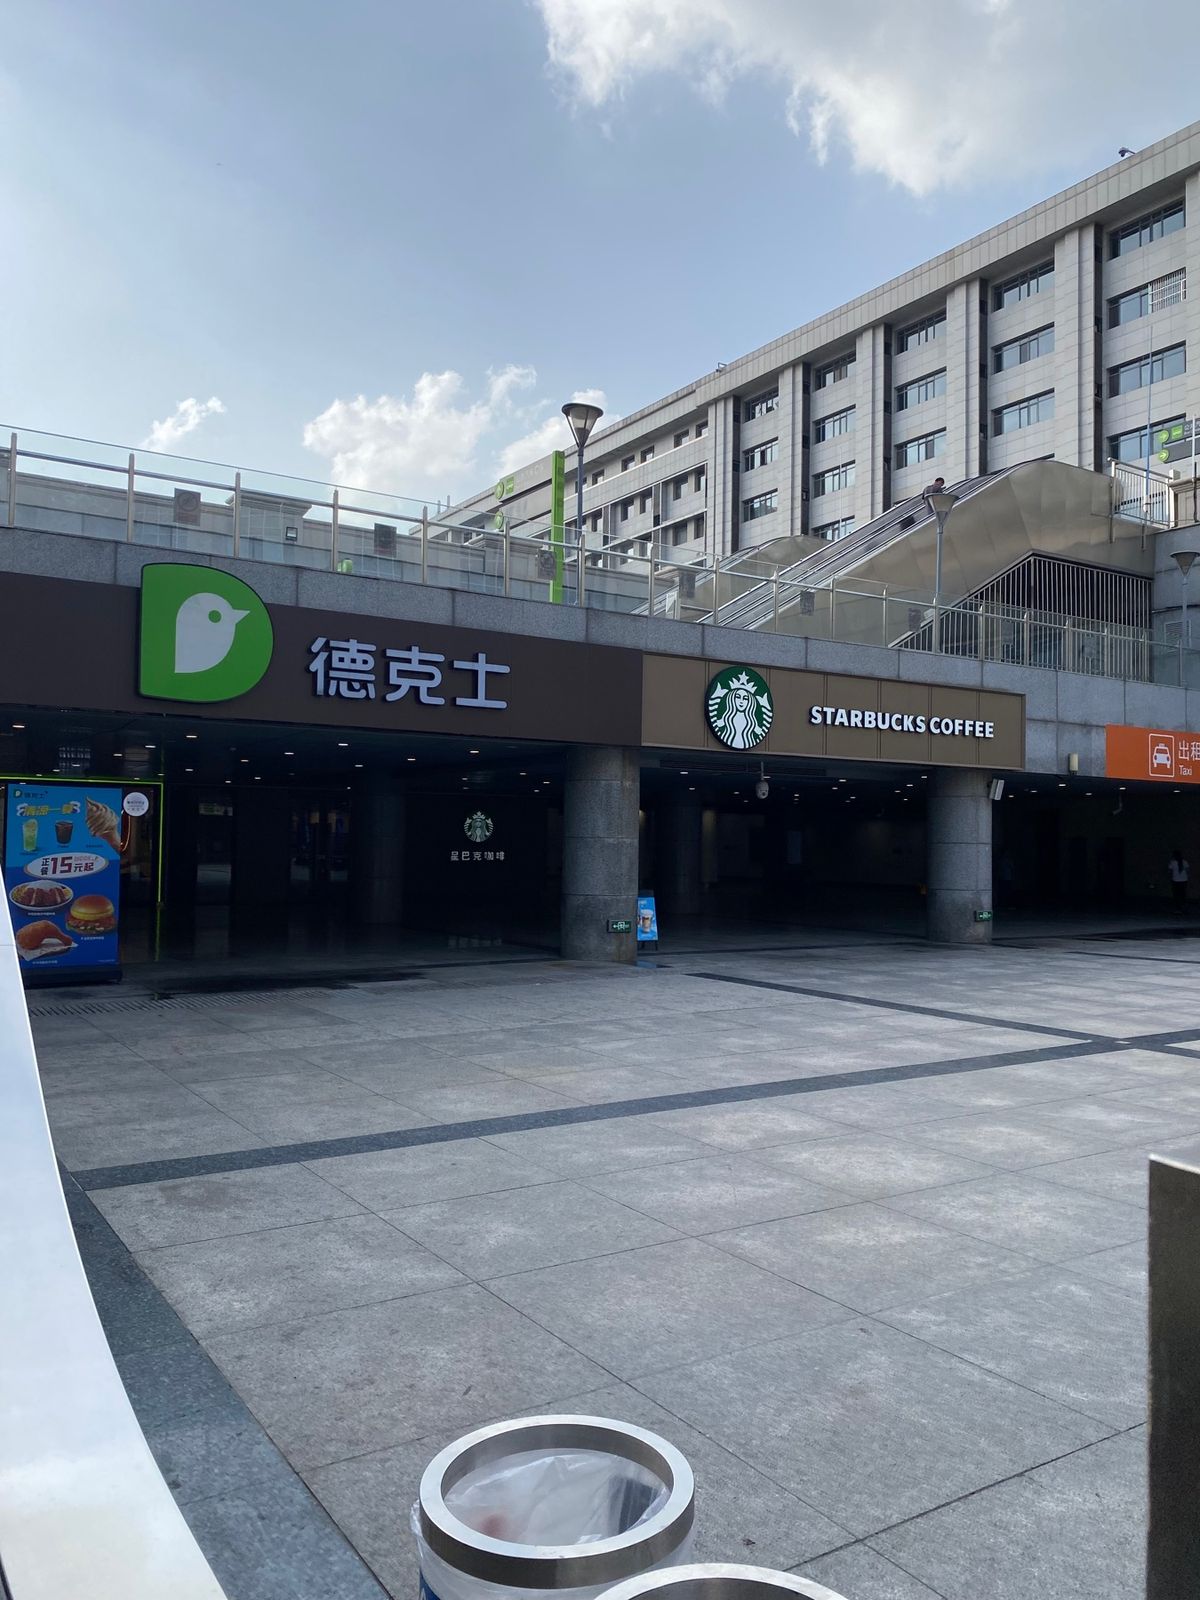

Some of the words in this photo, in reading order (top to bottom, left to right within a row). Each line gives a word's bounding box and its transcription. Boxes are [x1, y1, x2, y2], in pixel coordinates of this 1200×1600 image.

[308, 636, 511, 710] 德克士
[810, 705, 926, 733] STARBUCKS
[929, 717, 995, 738] COFFEE
[1179, 765, 1193, 776] Taxi
[450, 850, 505, 861] 星巴克咖啡
[50, 856, 73, 875] 15
[73, 862, 94, 873] 元起
